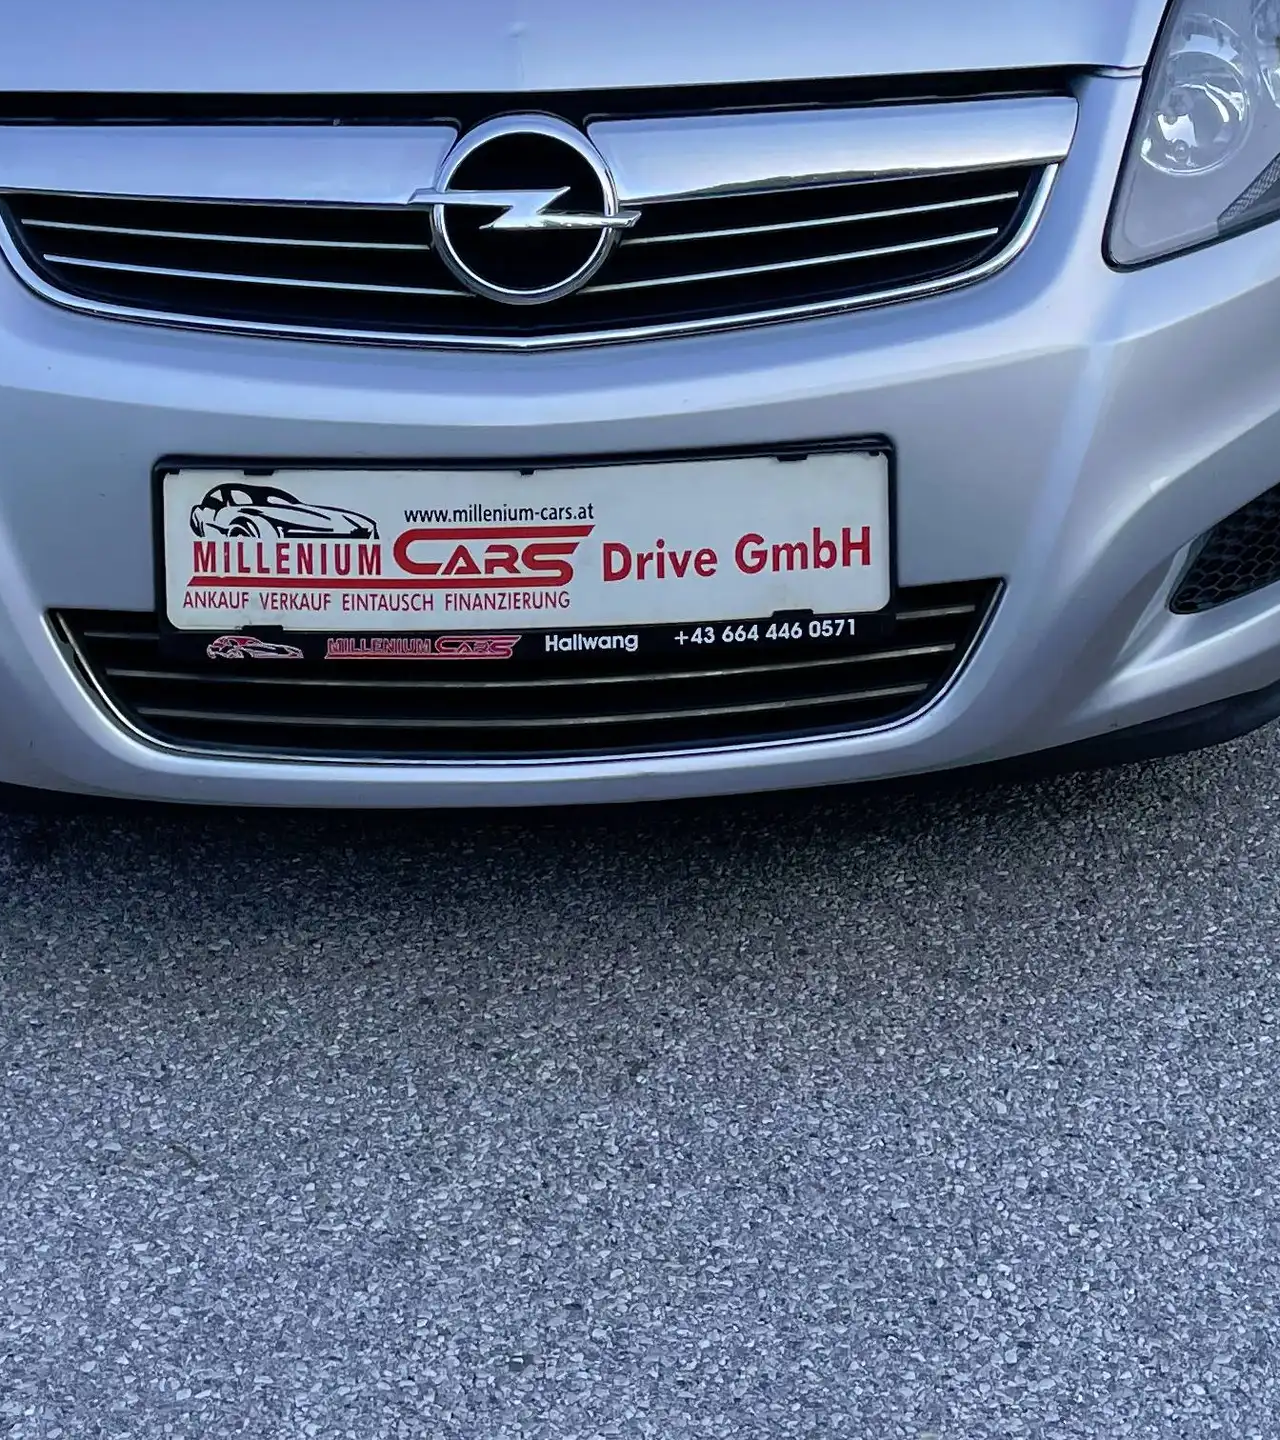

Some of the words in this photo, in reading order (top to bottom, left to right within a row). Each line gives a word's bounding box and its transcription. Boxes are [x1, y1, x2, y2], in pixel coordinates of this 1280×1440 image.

[404, 503, 595, 524] www.millenium-cars.at
[193, 541, 382, 576] MILLENIUM
[393, 525, 596, 586] CARS
[602, 538, 718, 582] Drive
[734, 526, 871, 575] GmbH
[183, 591, 250, 609] ANKAUF
[259, 592, 332, 611] VERKAUF
[342, 593, 434, 612] EINTAUSCH
[444, 591, 571, 611] FINANZIERUNG
[545, 634, 639, 652] Hallwang
[674, 626, 715, 646] +43
[721, 624, 759, 642] 664
[765, 622, 803, 639] 446
[808, 618, 856, 638] 0571
